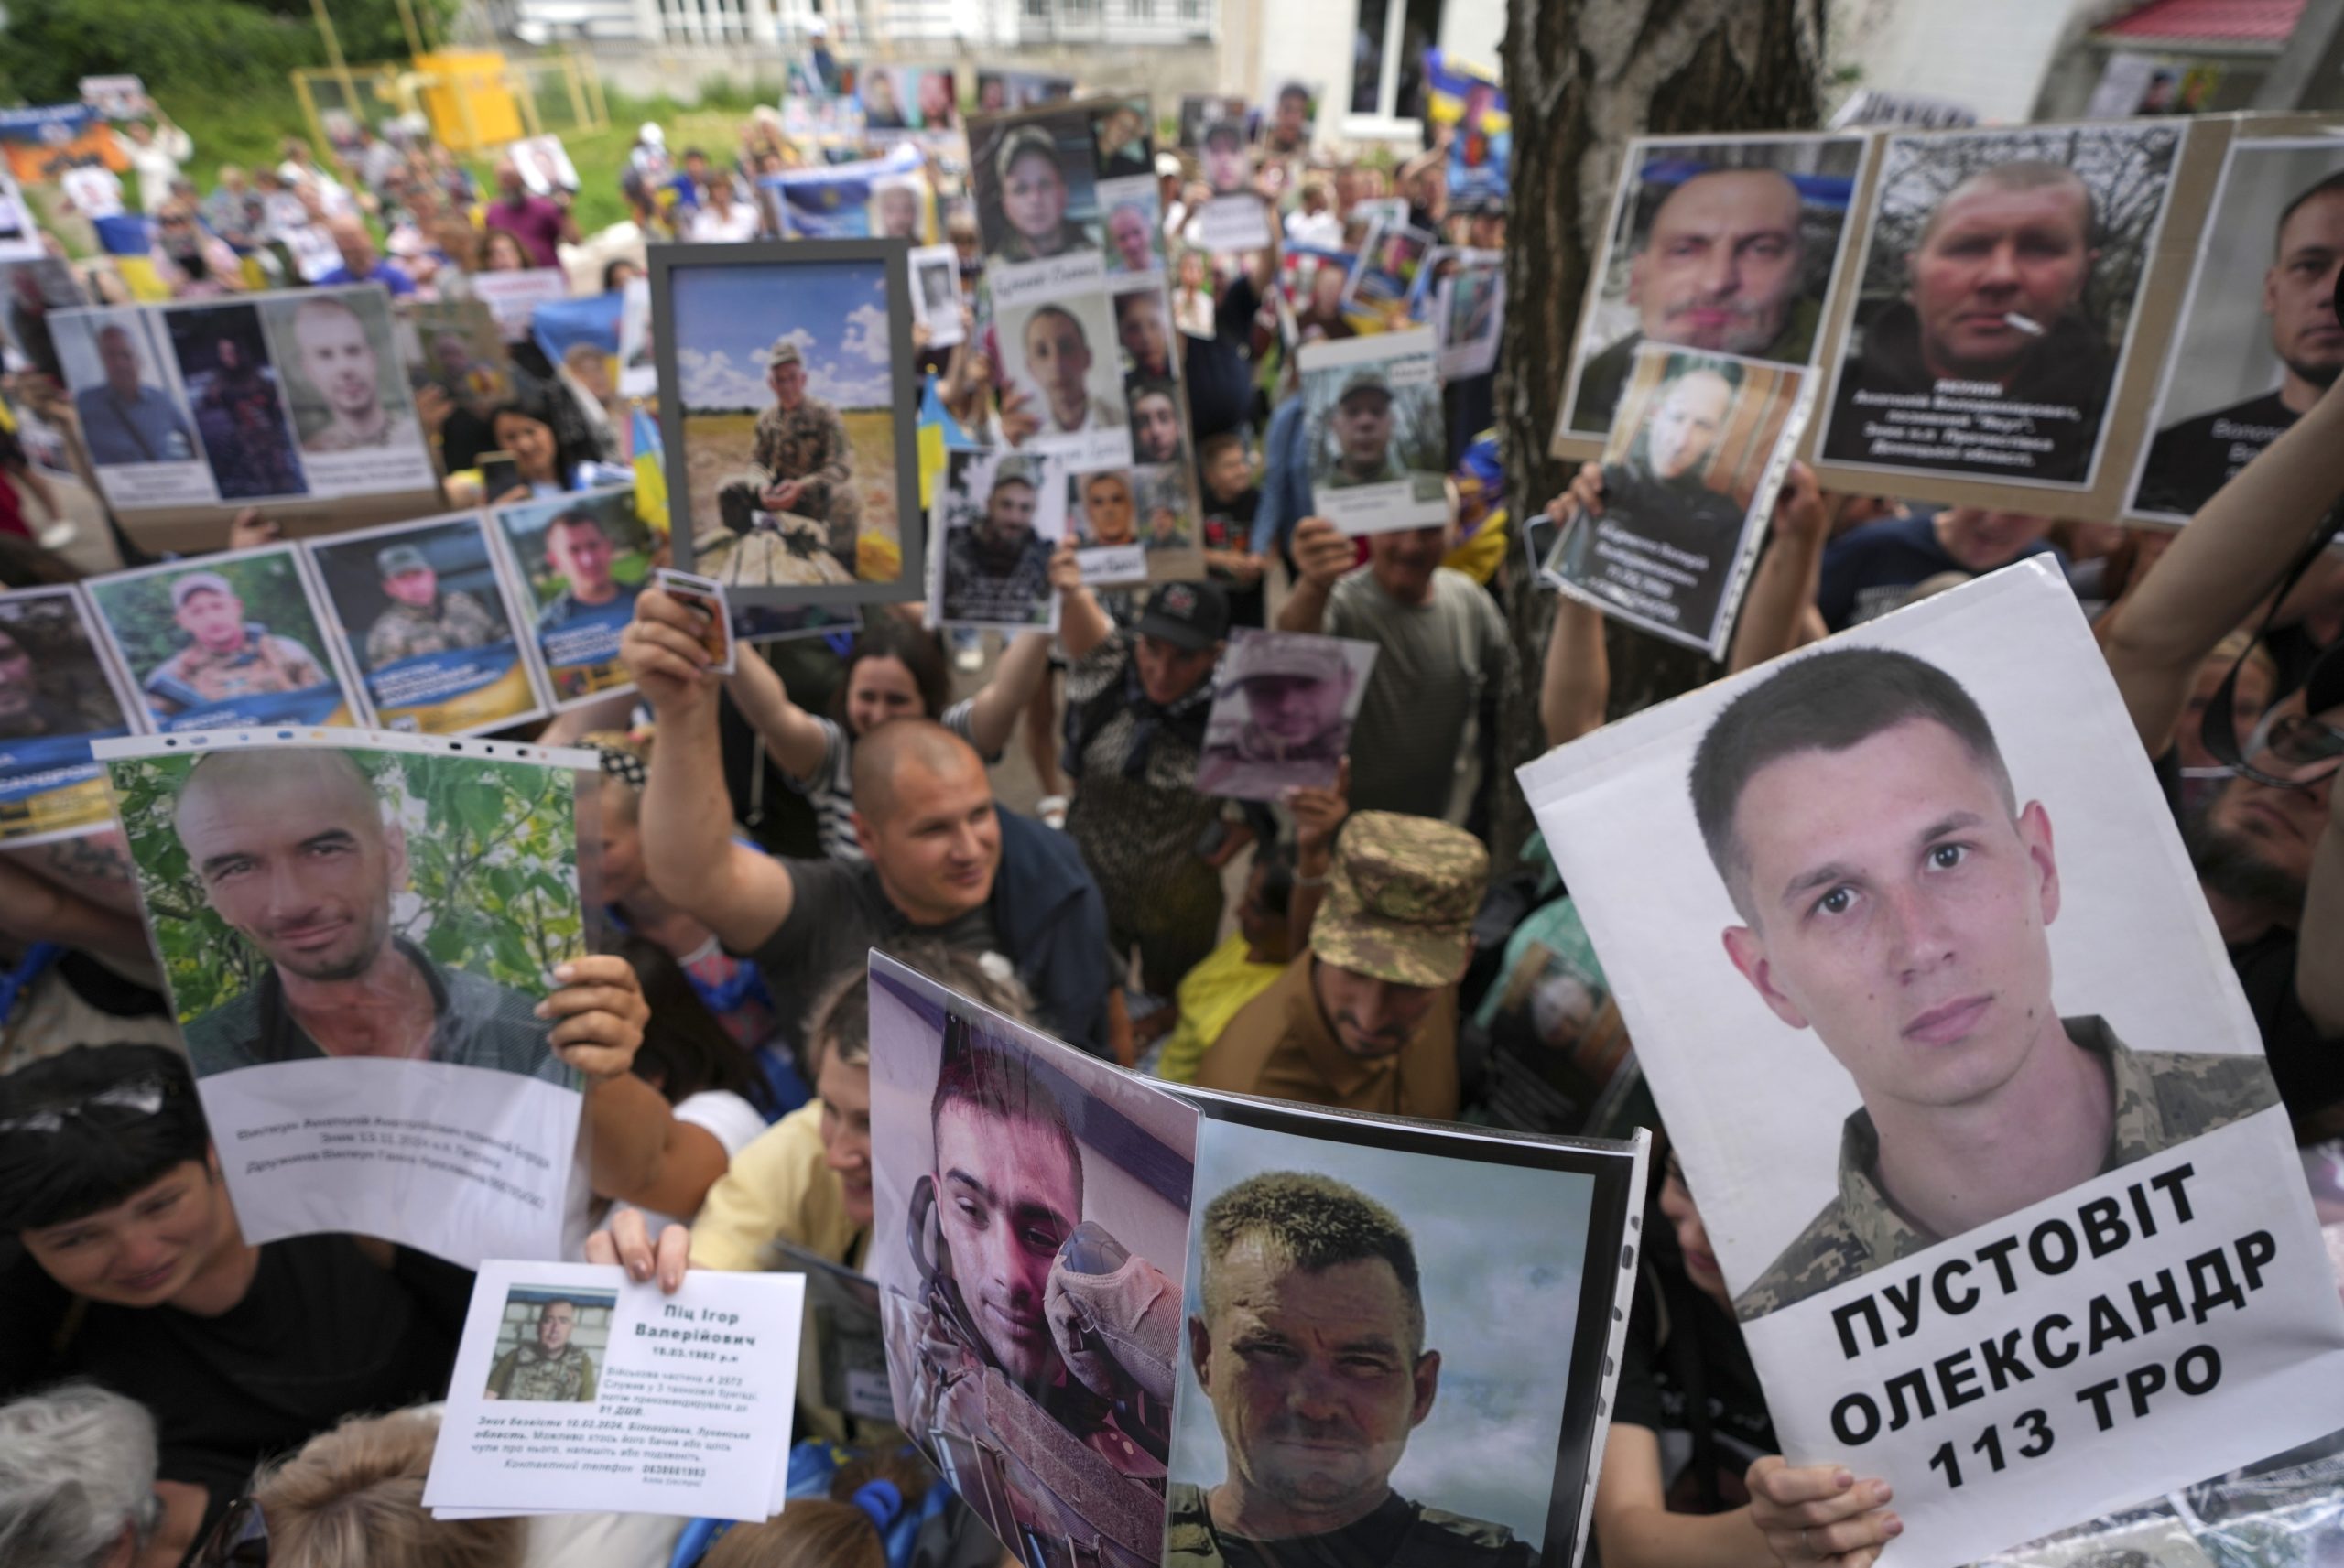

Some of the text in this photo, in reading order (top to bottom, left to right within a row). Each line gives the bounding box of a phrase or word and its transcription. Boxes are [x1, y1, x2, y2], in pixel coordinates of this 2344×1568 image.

[1831, 1162, 2195, 1360] ПУСТОВІТ
[664, 1304, 739, 1325] Піц Ігор
[635, 1323, 755, 1346] Валерійович
[1830, 1230, 2276, 1446] ОЛЕКСАНДР
[662, 1372, 703, 1383] частина
[1928, 1344, 2222, 1489] 113 ТРО
[533, 1431, 584, 1441] Можливо
[505, 1459, 579, 1471] Контактний
[582, 1463, 633, 1474] телефон
